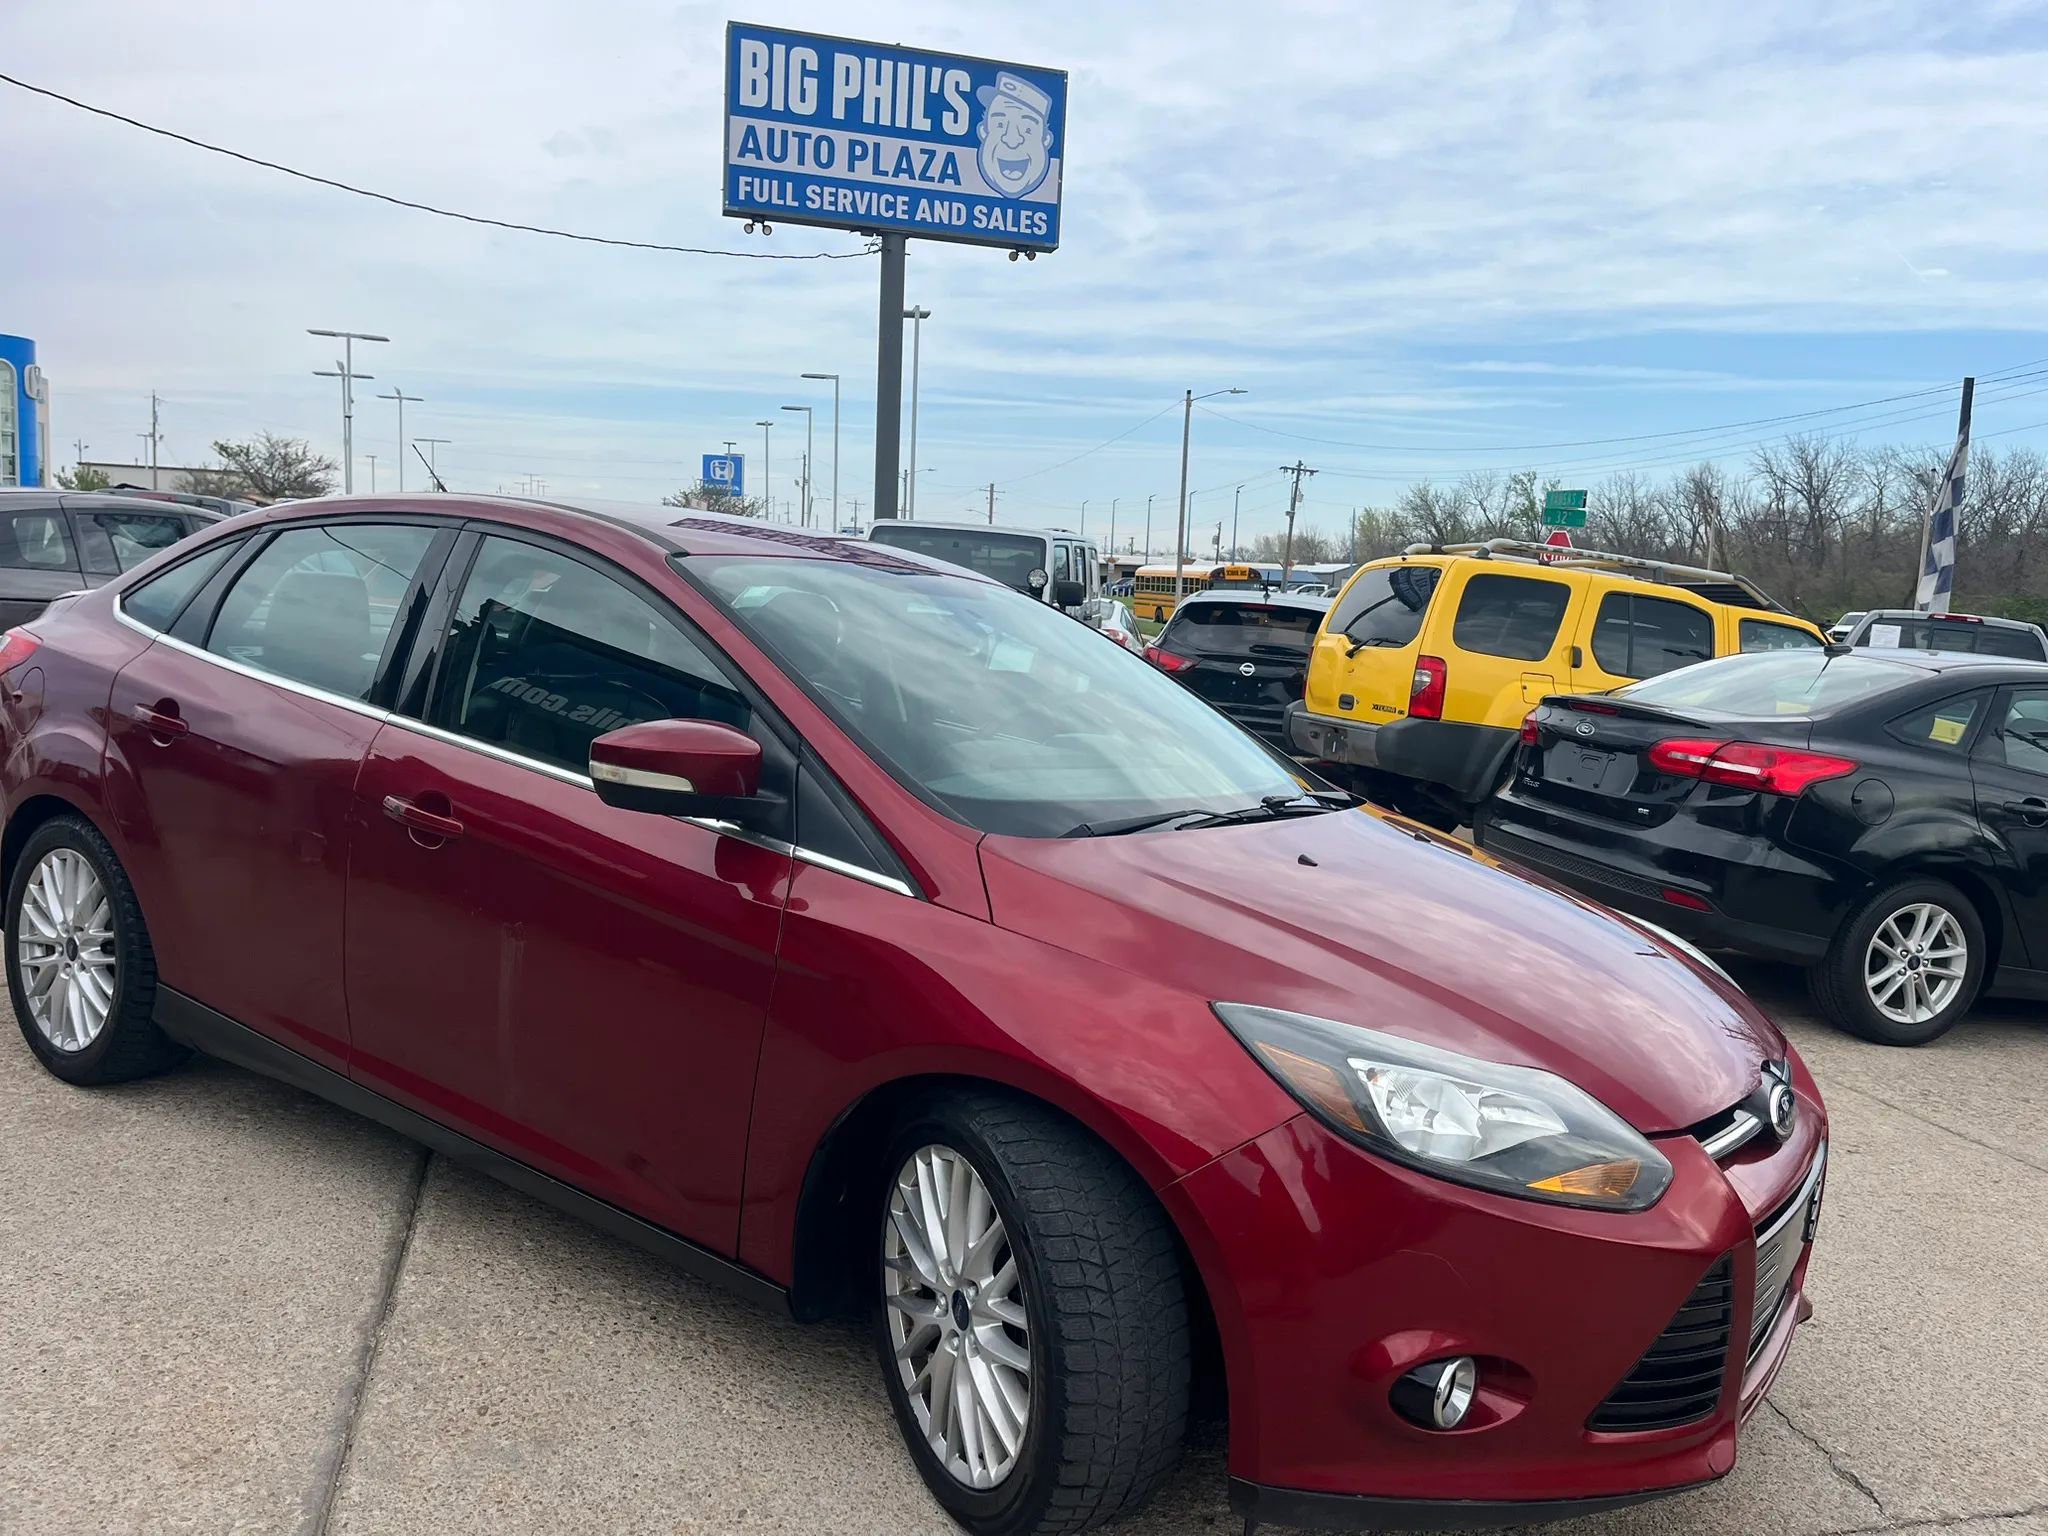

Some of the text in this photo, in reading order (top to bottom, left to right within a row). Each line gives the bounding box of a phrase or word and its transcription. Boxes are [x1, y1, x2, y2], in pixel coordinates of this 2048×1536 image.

[739, 38, 971, 136] BIG PHIL'S
[737, 125, 962, 186] AUTO PLAZA
[738, 176, 1048, 235] FULL SERVICE AND SALES
